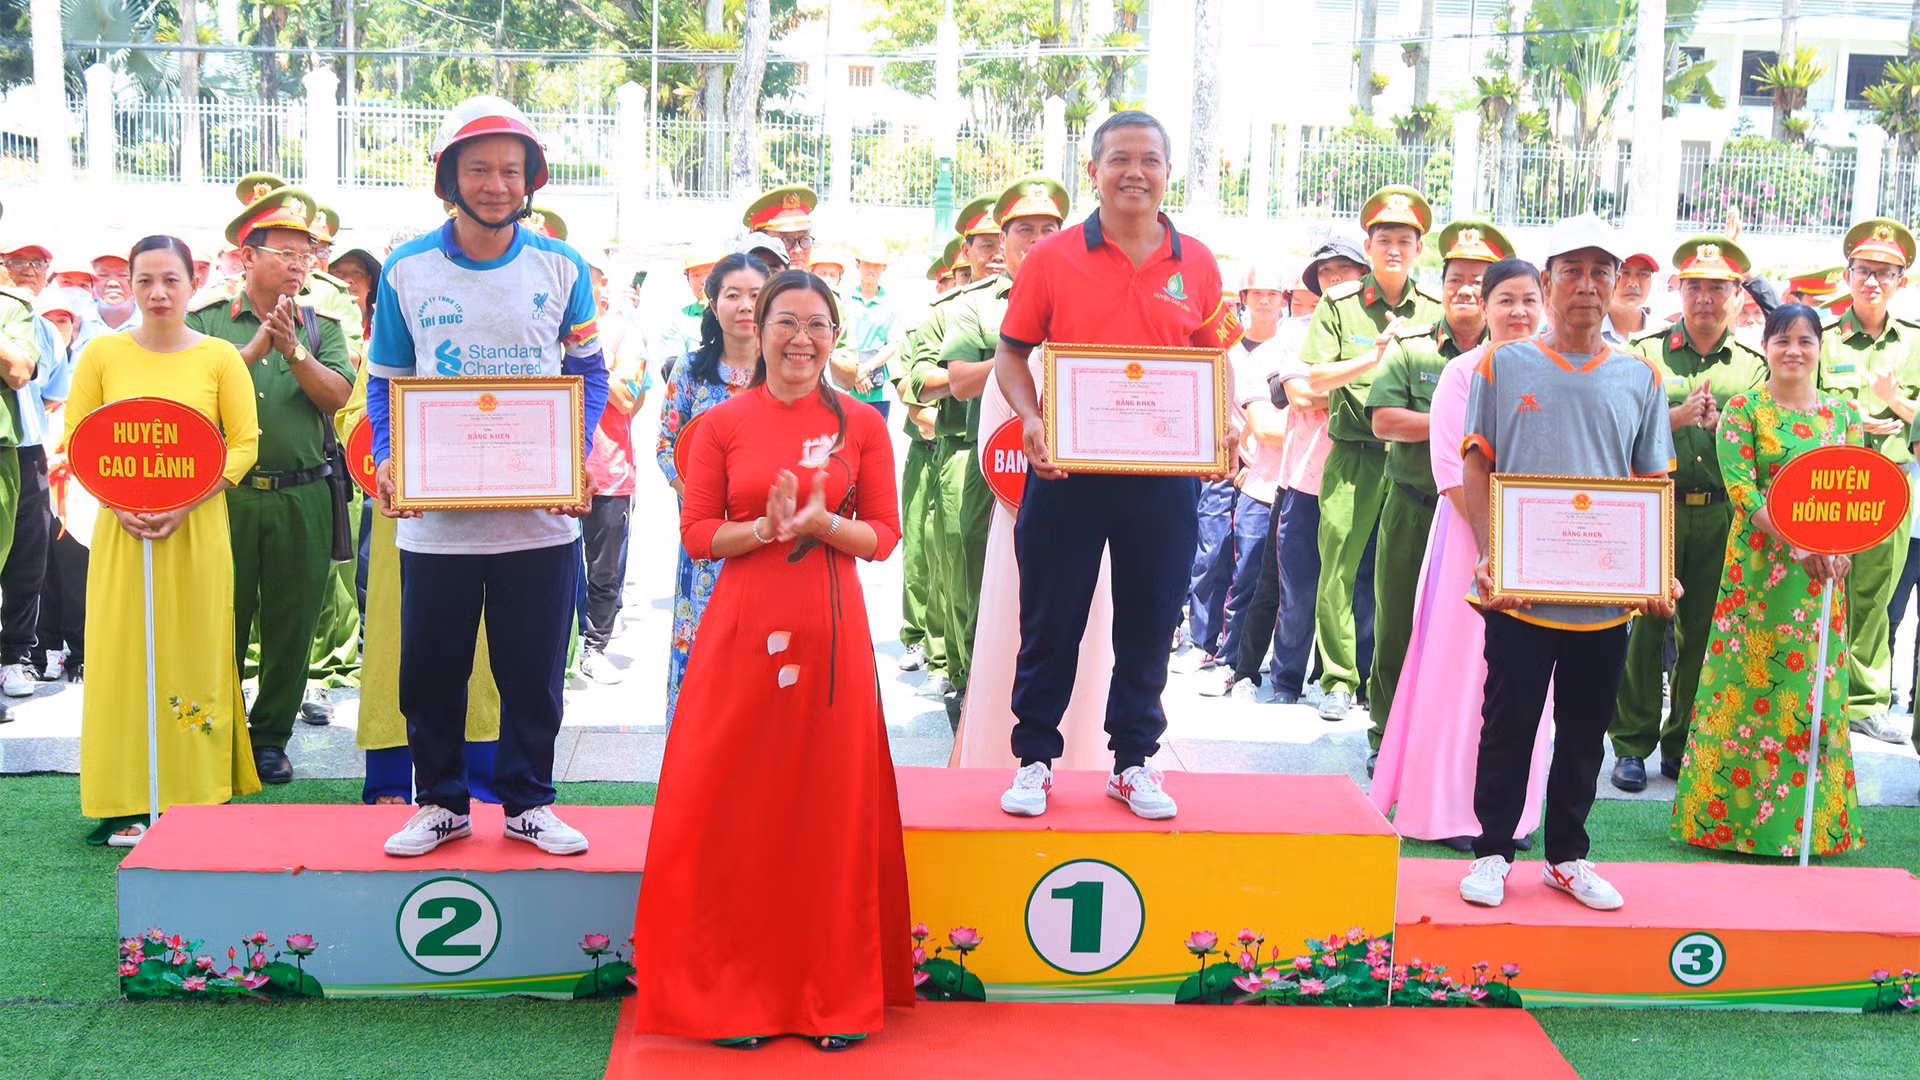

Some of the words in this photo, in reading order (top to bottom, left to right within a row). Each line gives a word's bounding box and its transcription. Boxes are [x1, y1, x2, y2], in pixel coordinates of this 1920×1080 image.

[468, 344, 542, 359] Standard
[463, 361, 541, 375] Chartered
[113, 418, 178, 449] HUYỆN
[99, 455, 136, 478] CAO
[143, 452, 194, 478] LÃNH
[994, 449, 1028, 473] BAN
[1810, 465, 1870, 494] HUYỆN
[1792, 494, 1841, 522] HỒNG
[1846, 499, 1886, 526] NGỰ
[416, 897, 482, 956] 2
[1051, 881, 1104, 953] 1
[1680, 943, 1715, 975] 3
